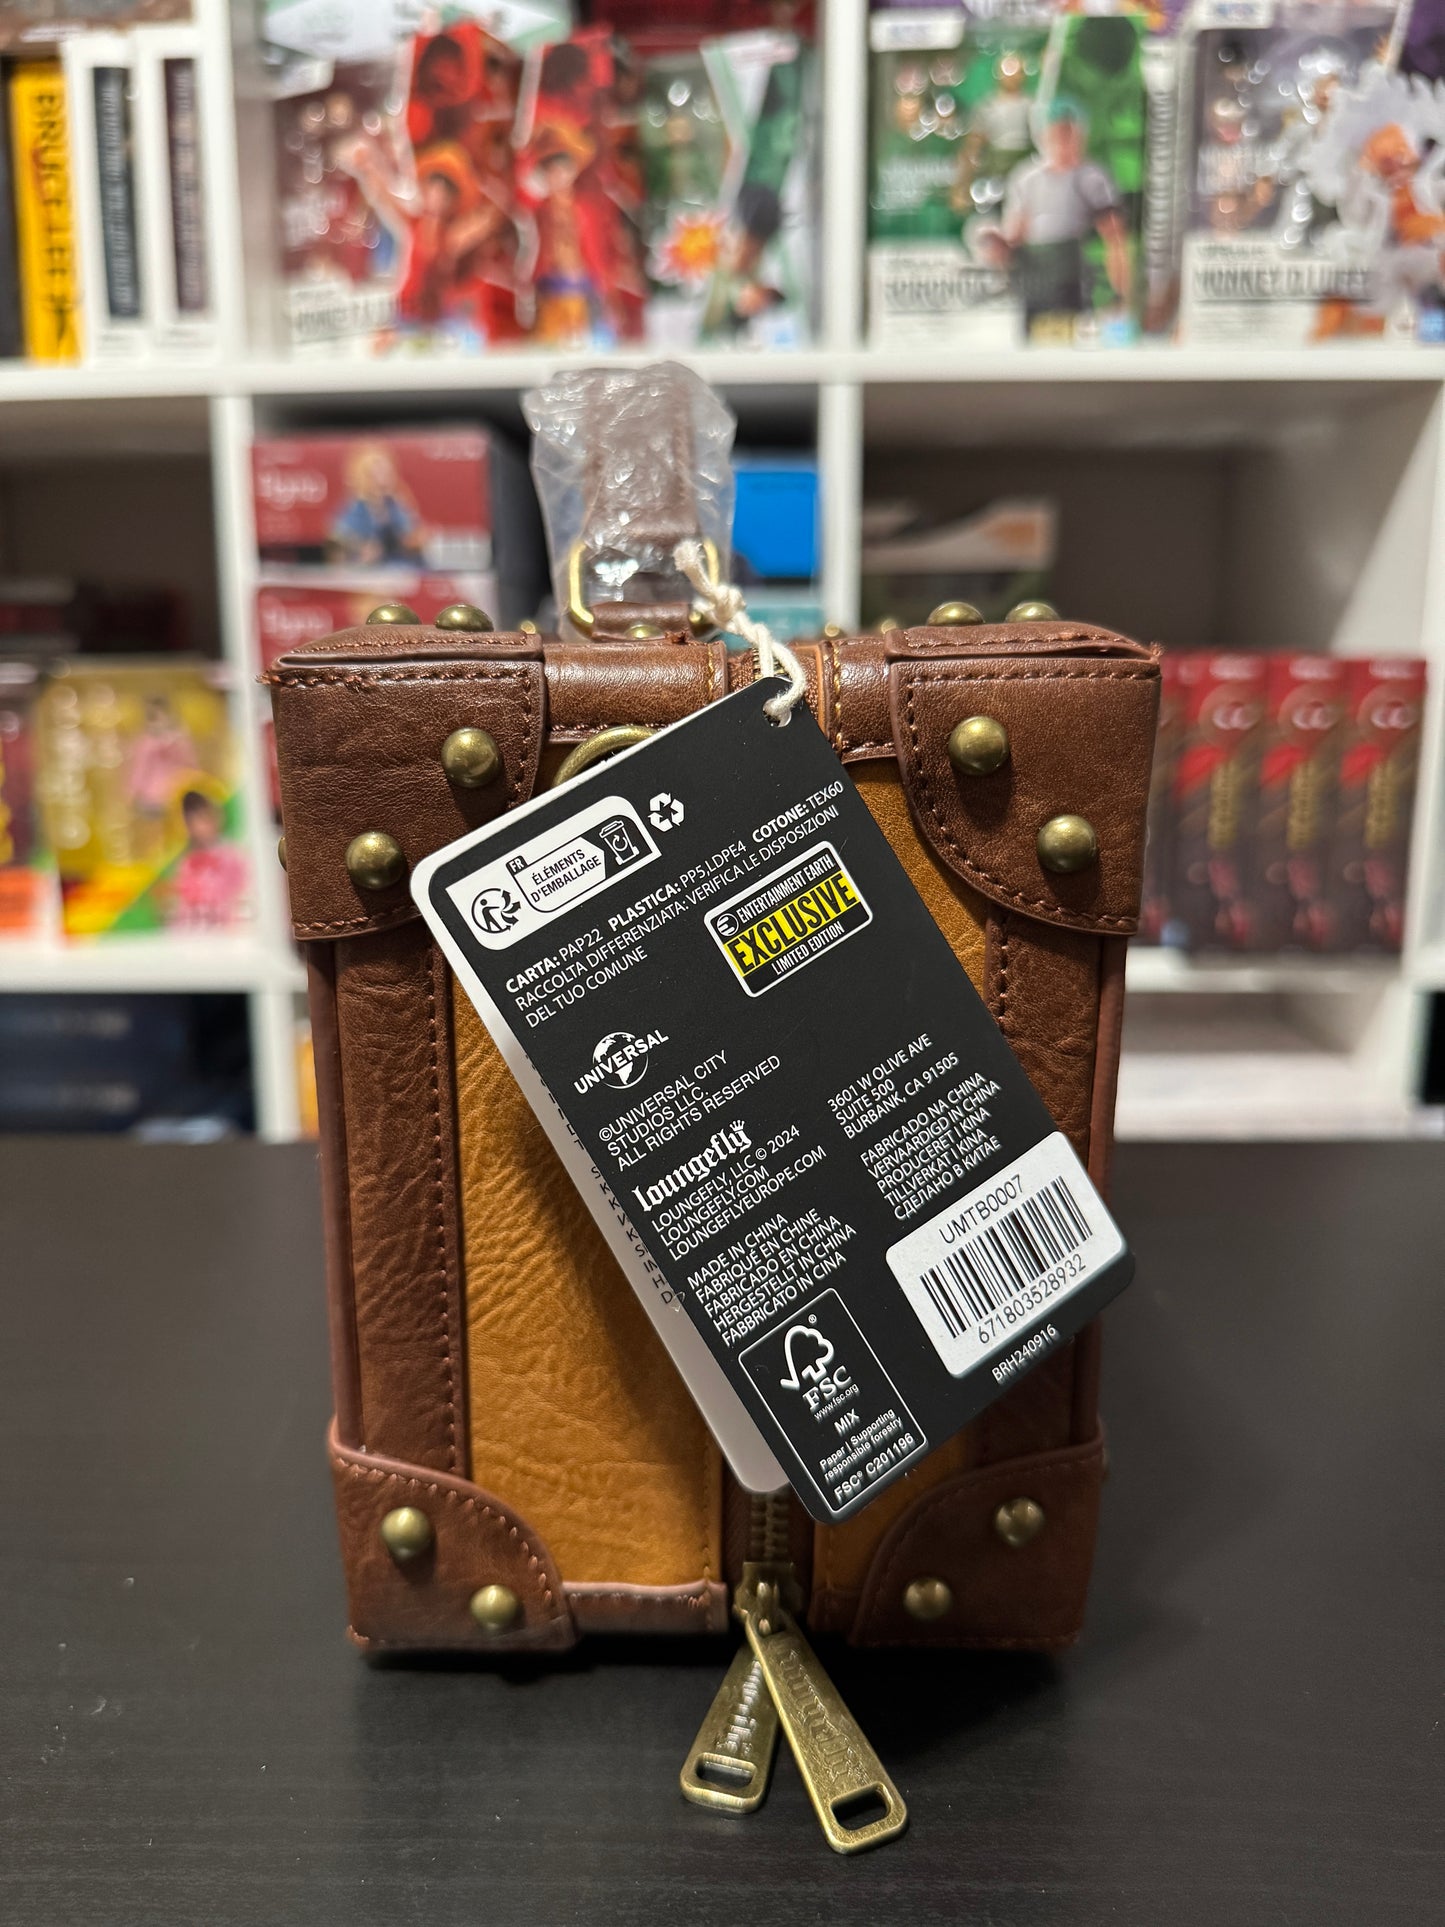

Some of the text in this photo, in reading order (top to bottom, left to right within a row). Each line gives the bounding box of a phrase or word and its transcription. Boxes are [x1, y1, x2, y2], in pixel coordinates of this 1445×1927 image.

[508, 858, 525, 873] FR
[531, 849, 586, 886] ÉLÉMENTS
[679, 780, 844, 888] PP5,LDPE4 COTONE: TEX60
[685, 804, 839, 905] VERIFICA LE DISPOSIZIONI
[530, 855, 602, 903] D'EMBALLAGE
[736, 853, 835, 924] ENTERTAINMENT EARTH
[505, 882, 682, 993] CARTA: PAP22 PLASTICA:
[515, 900, 689, 1011] RACCOLTA DIFFERENZIATA:
[726, 872, 859, 977] EXCLUSIVE
[771, 920, 845, 976] LIMITED EDITION
[525, 945, 648, 1028] DEL TUO COMUNE
[573, 1029, 669, 1094] UNIVERSAL
[693, 1049, 727, 1080] CITY
[827, 1033, 932, 1112] 3601 W OLIVE AVE
[835, 1078, 895, 1126] SUITE 500
[843, 1052, 958, 1139] BURBANK, CA 91505
[607, 1086, 709, 1157] STUDIOS LLC.
[618, 1055, 780, 1172] ALL RIGHTS RESERVED
[860, 1072, 986, 1167] FABRICADO NA CHINA
[867, 1080, 1000, 1179] VERVAARDIGD IN CHINA
[876, 1107, 991, 1194] PRODUCERET I KINA
[631, 1119, 752, 1212] loungefly
[651, 1124, 800, 1233] LOUNGEFLY, LLC © 2024
[660, 1165, 770, 1247] LOUNGEFLY.COM
[669, 1145, 827, 1261] LOUNGEFLYEUROPE.COM
[883, 1128, 987, 1206] TILLVERKAT I KINA
[894, 1135, 1001, 1220] СДЕЛАНО В КИТАЕ
[938, 1174, 1023, 1244] UMTB0007
[687, 1213, 788, 1290] MADE IN CHINA
[695, 1208, 821, 1304] FABRIQUÉ EN CHINE
[704, 1215, 841, 1318] FABRICADO EN CHINA
[712, 1224, 857, 1333] HERGESTELLT IN CHINA
[721, 1251, 847, 1347] FABBRICATO IN CINA
[978, 1253, 1087, 1344] 671803528932
[802, 1365, 851, 1411] FSC
[991, 1323, 1057, 1382] BRH240916
[814, 1383, 860, 1420] www.fsc.org
[819, 1446, 846, 1471] Paper
[850, 1409, 896, 1447] Supporting
[834, 1408, 860, 1434] MIX
[824, 1417, 902, 1481] responsible forestry
[865, 1432, 914, 1476] C201196
